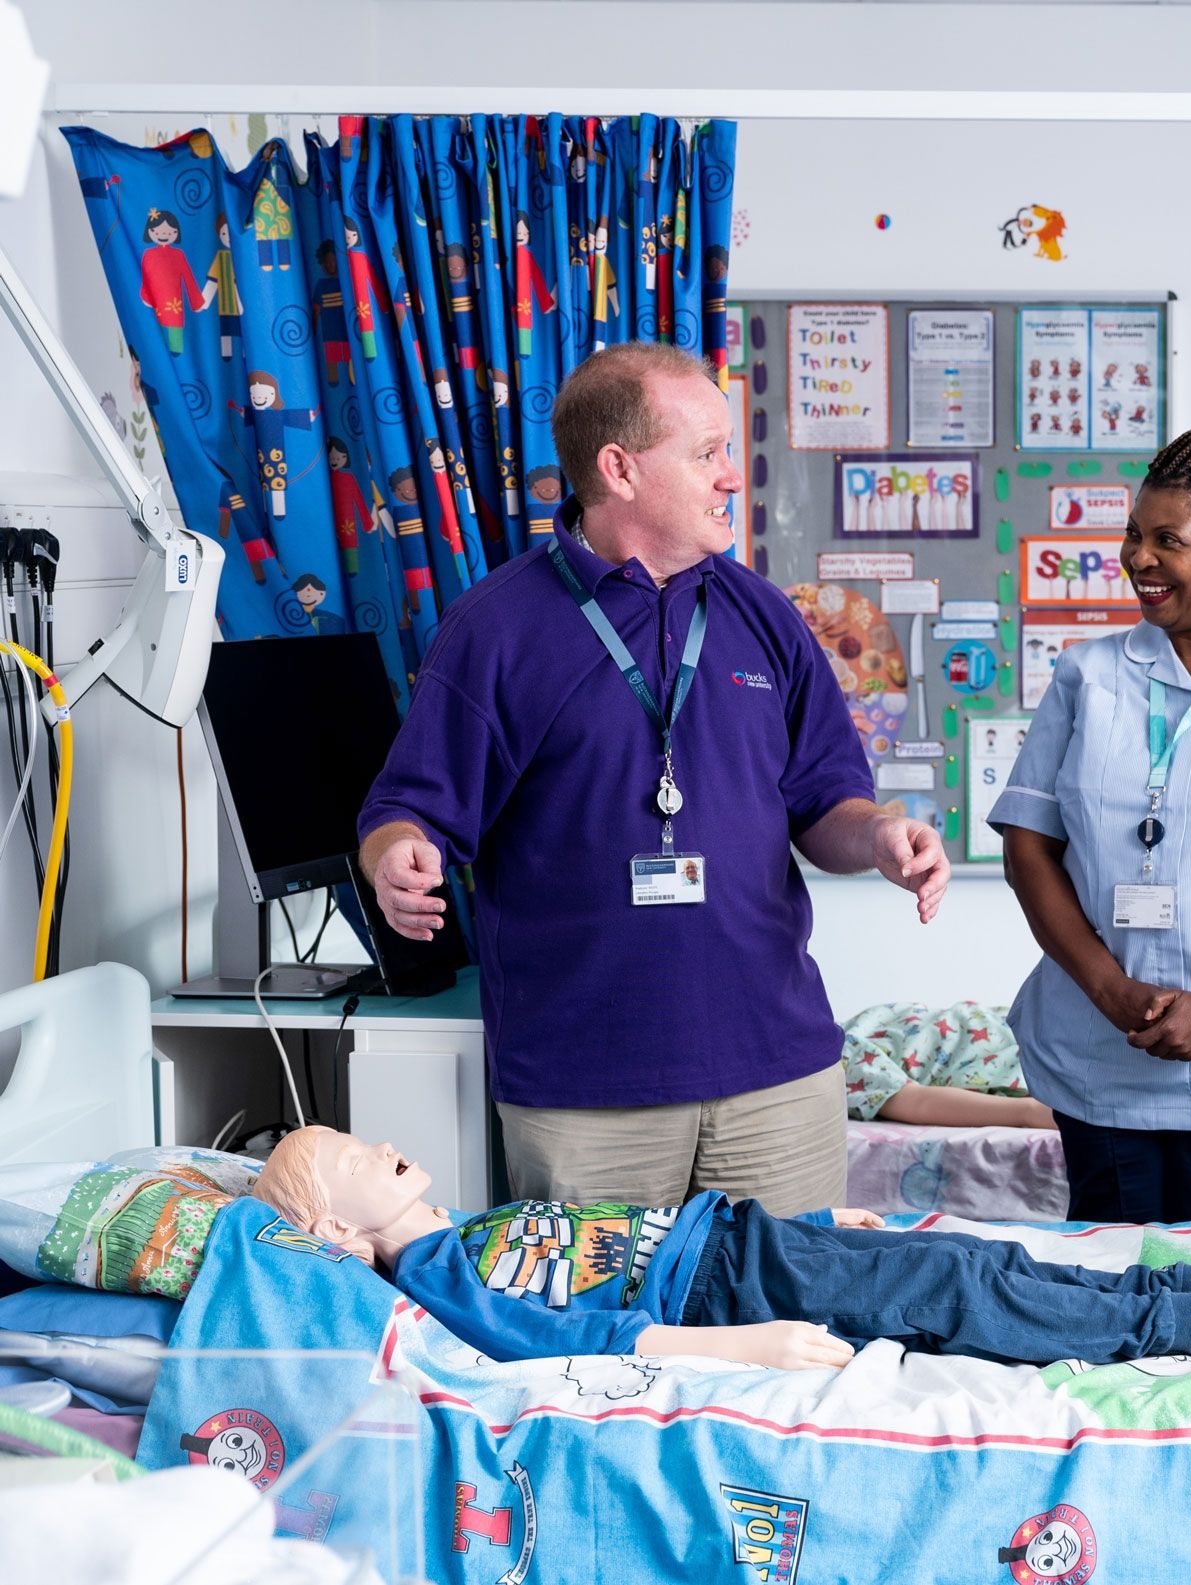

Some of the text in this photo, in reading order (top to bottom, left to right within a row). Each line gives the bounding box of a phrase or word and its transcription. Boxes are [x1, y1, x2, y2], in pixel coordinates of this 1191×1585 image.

[799, 353, 871, 372] Thirsty
[846, 465, 970, 497] Diabetes
[820, 557, 912, 567] Starchy Vegetables
[1036, 550, 1128, 580] Seps
[863, 569, 905, 577] Legumes
[1077, 612, 1108, 621] SEPSIS
[745, 672, 767, 683] bucks
[900, 744, 942, 754] Protein
[226, 1412, 272, 1437] TRAIN
[775, 1510, 798, 1582] THOMAS
